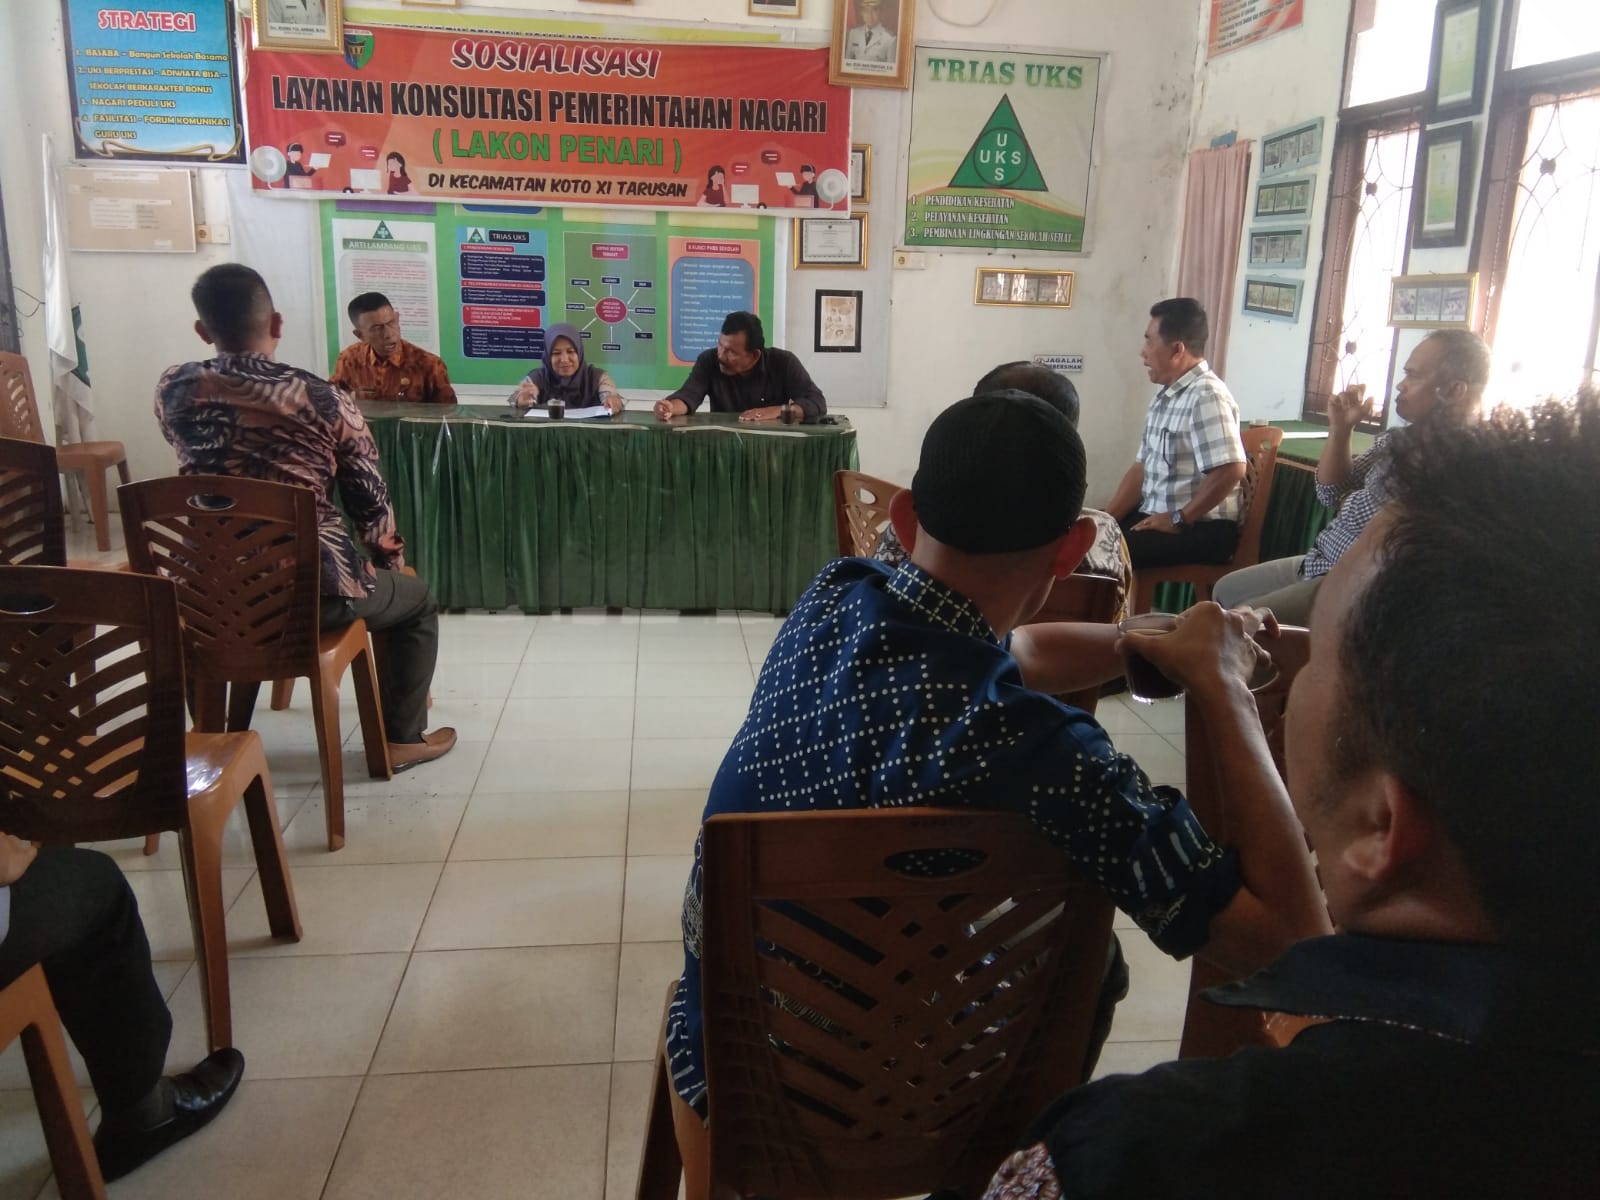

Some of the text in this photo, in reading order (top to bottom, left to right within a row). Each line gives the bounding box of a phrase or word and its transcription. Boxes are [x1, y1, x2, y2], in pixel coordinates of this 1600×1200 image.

[98, 9, 196, 32] STRATEGI
[128, 50, 160, 60] Bangun
[162, 52, 193, 60] Sekolah
[451, 38, 661, 79] SOSIALISASI
[103, 67, 154, 76] BERPRESTASI
[927, 57, 1083, 89] TRIAS UKS
[127, 84, 184, 93] BERKARAKTER
[185, 86, 213, 94] BONUS
[91, 98, 126, 106] NAGARI
[127, 99, 159, 108] PEDULI
[160, 100, 176, 108] UKS
[272, 75, 826, 133] LAYANAN KONSULTASI PEMERINTAHAN NAGARI
[93, 114, 137, 123] FASILITASI
[143, 116, 175, 125] FORUM
[176, 117, 230, 127] KOMUNIKASI
[94, 130, 137, 139] GURU UKS
[452, 129, 550, 162] LAKON
[560, 134, 664, 166] PENARI
[428, 173, 687, 197] DI KECAMATAN KOTO XI TARUSAN
[925, 195, 972, 206] PENDIDIKAN
[974, 197, 1015, 209] KESEHATAN
[924, 212, 966, 223] PELAYANAN
[968, 213, 1009, 224] KESEHATAN
[910, 227, 1073, 243] 3. PEMBINAAN LINGKUNGAN SEKOLAH SEHAT
